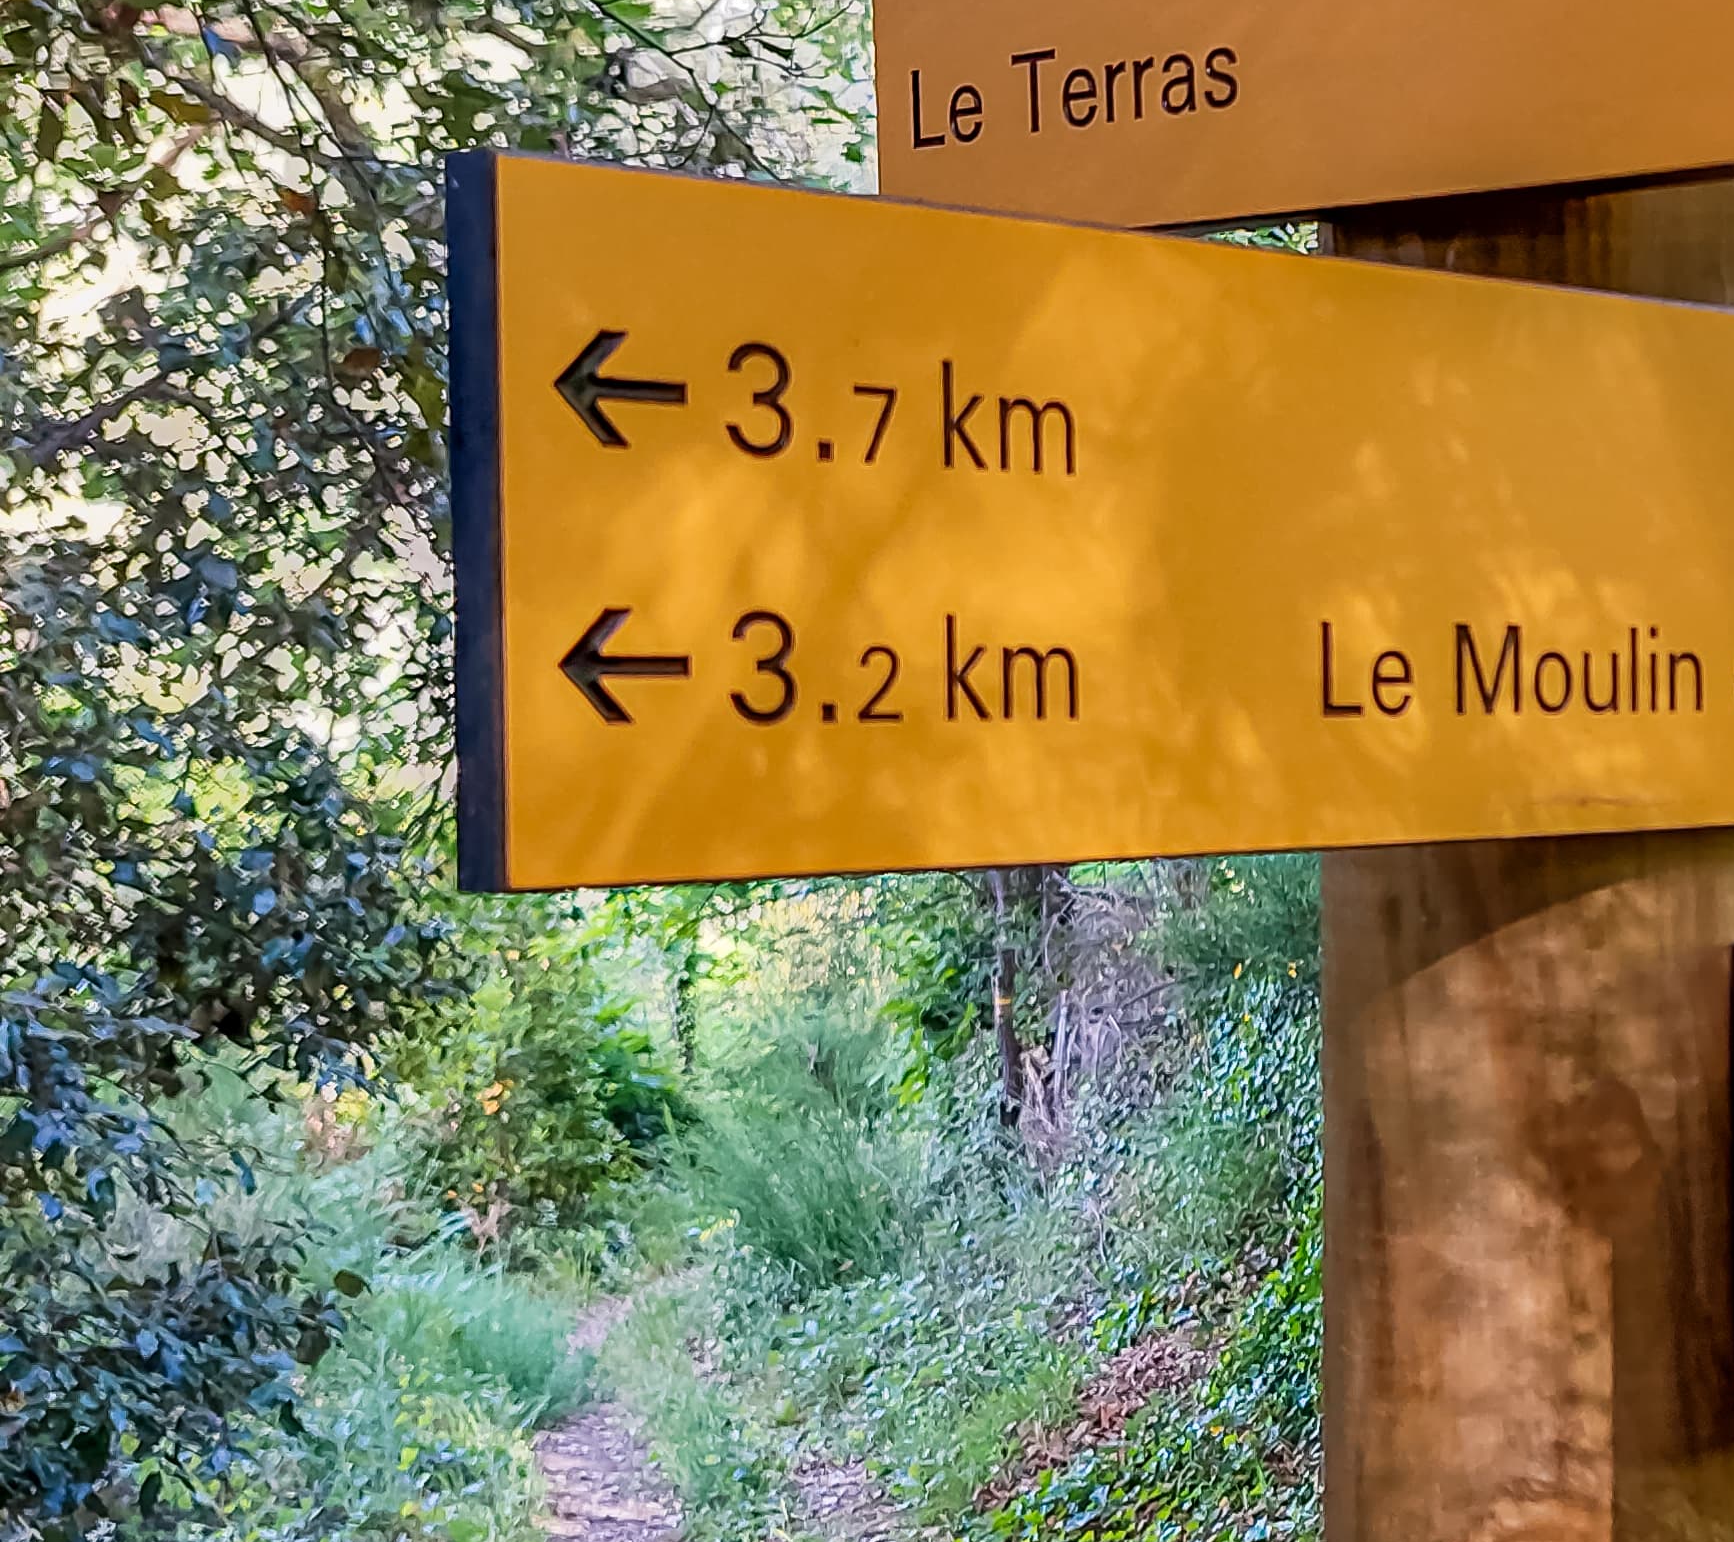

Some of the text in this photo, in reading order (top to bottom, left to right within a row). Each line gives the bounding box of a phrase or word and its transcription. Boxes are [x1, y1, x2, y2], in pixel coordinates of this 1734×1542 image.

[910, 46, 1240, 150] Le Terras
[724, 341, 1077, 476] 3.7 km
[729, 609, 1080, 724] 3.2 km
[1319, 619, 1414, 719] Le
[1453, 622, 1705, 716] Moulin
